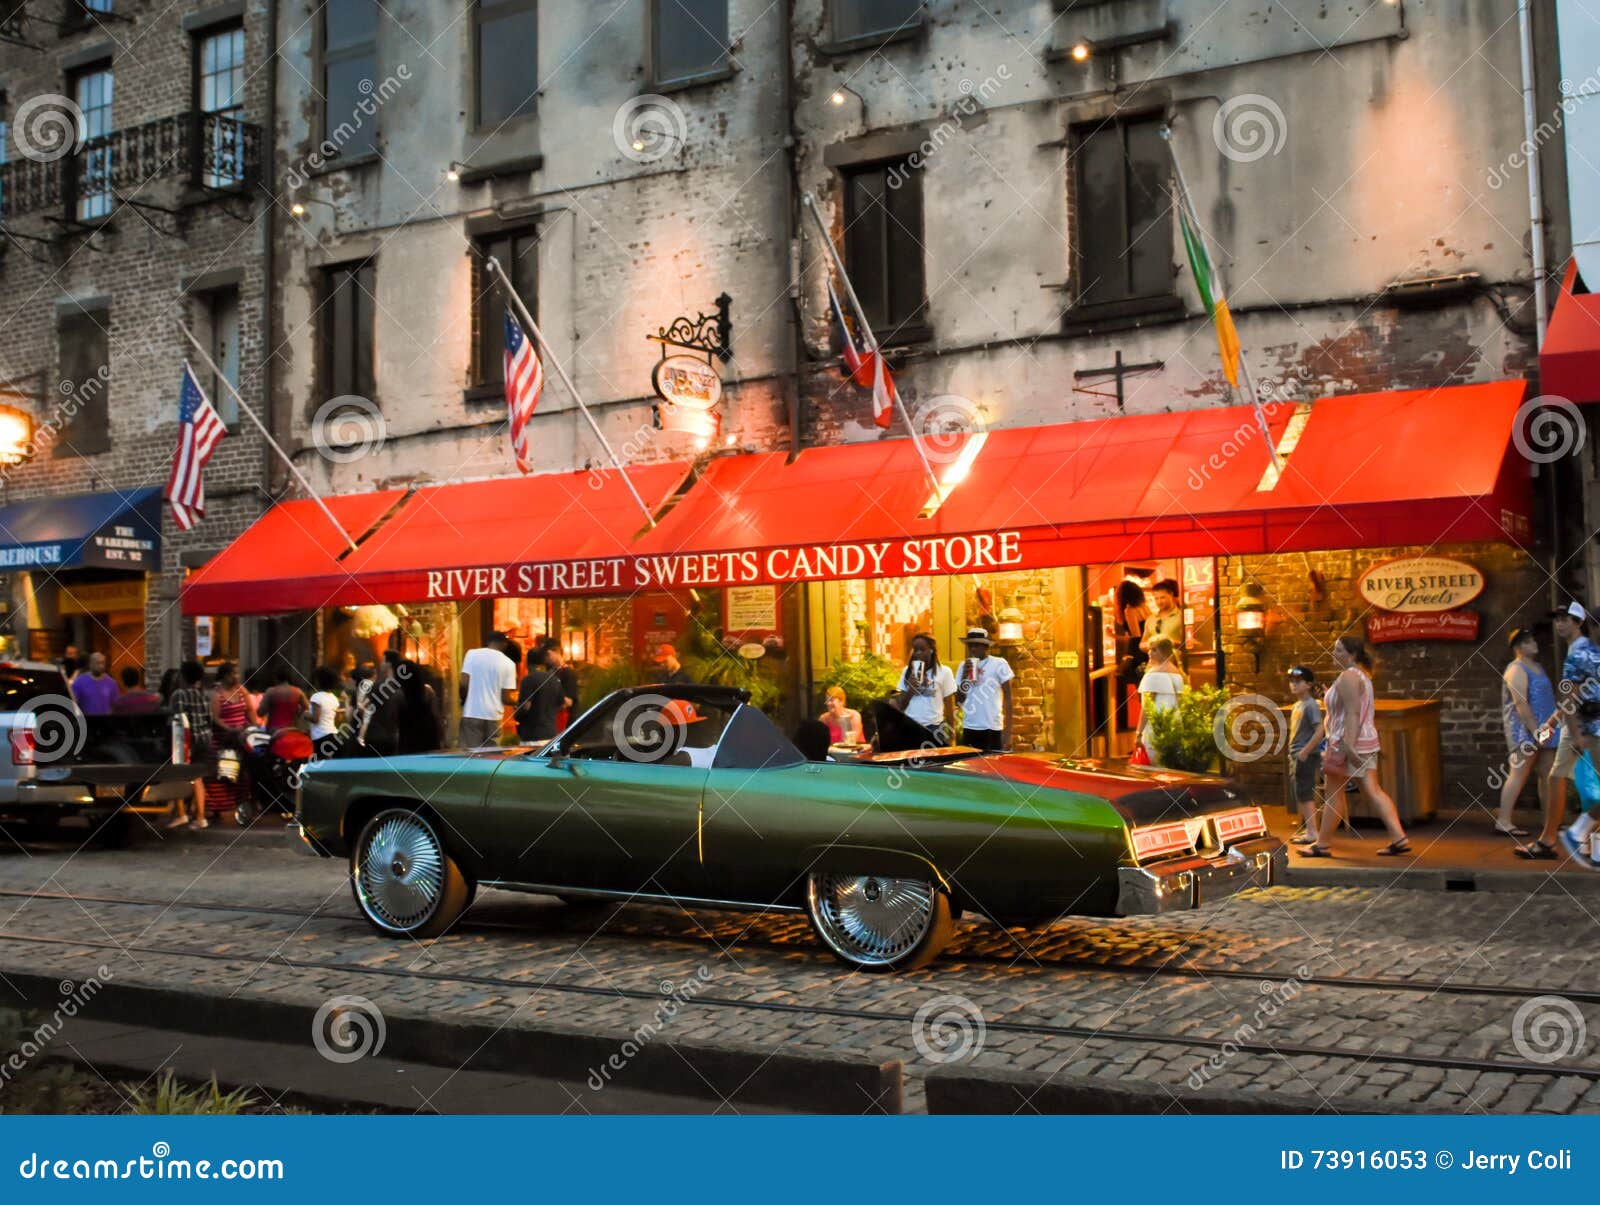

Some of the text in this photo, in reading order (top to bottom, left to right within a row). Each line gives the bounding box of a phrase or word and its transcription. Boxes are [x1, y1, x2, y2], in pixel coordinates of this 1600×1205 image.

[427, 531, 1022, 598] RIVER STREET SWEETS CANDY STORE
[1367, 573, 1478, 591] RIVER STREET
[1386, 585, 1453, 609] Sweets
